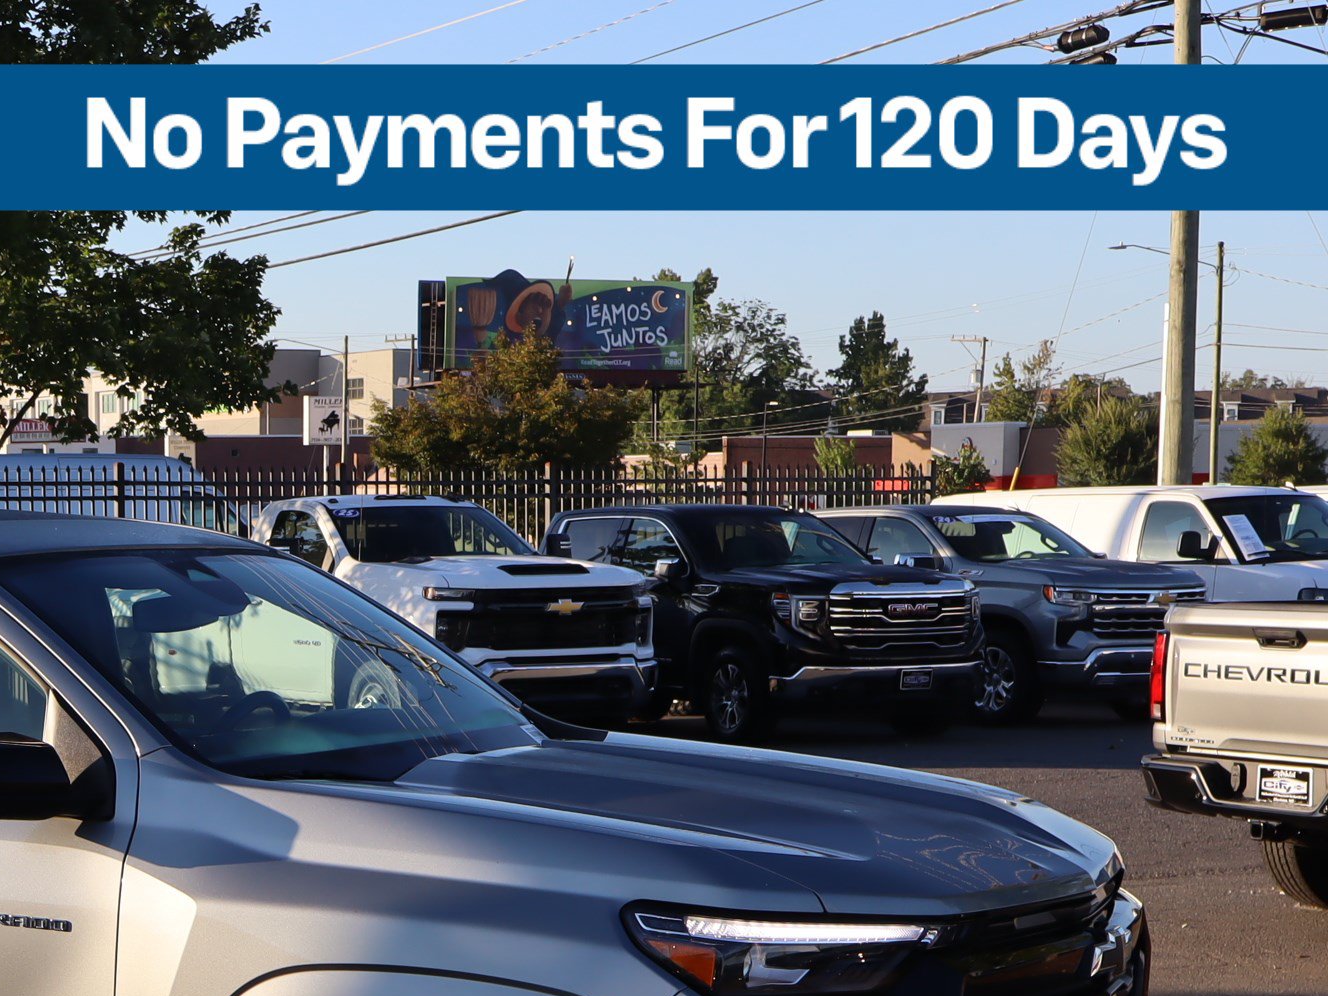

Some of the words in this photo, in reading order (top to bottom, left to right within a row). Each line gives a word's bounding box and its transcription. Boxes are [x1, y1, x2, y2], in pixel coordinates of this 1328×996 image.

[586, 302, 651, 327] LEAMOS
[596, 326, 668, 353] JUNTOS
[15, 421, 50, 432] MILLER
[888, 603, 939, 616] GMC
